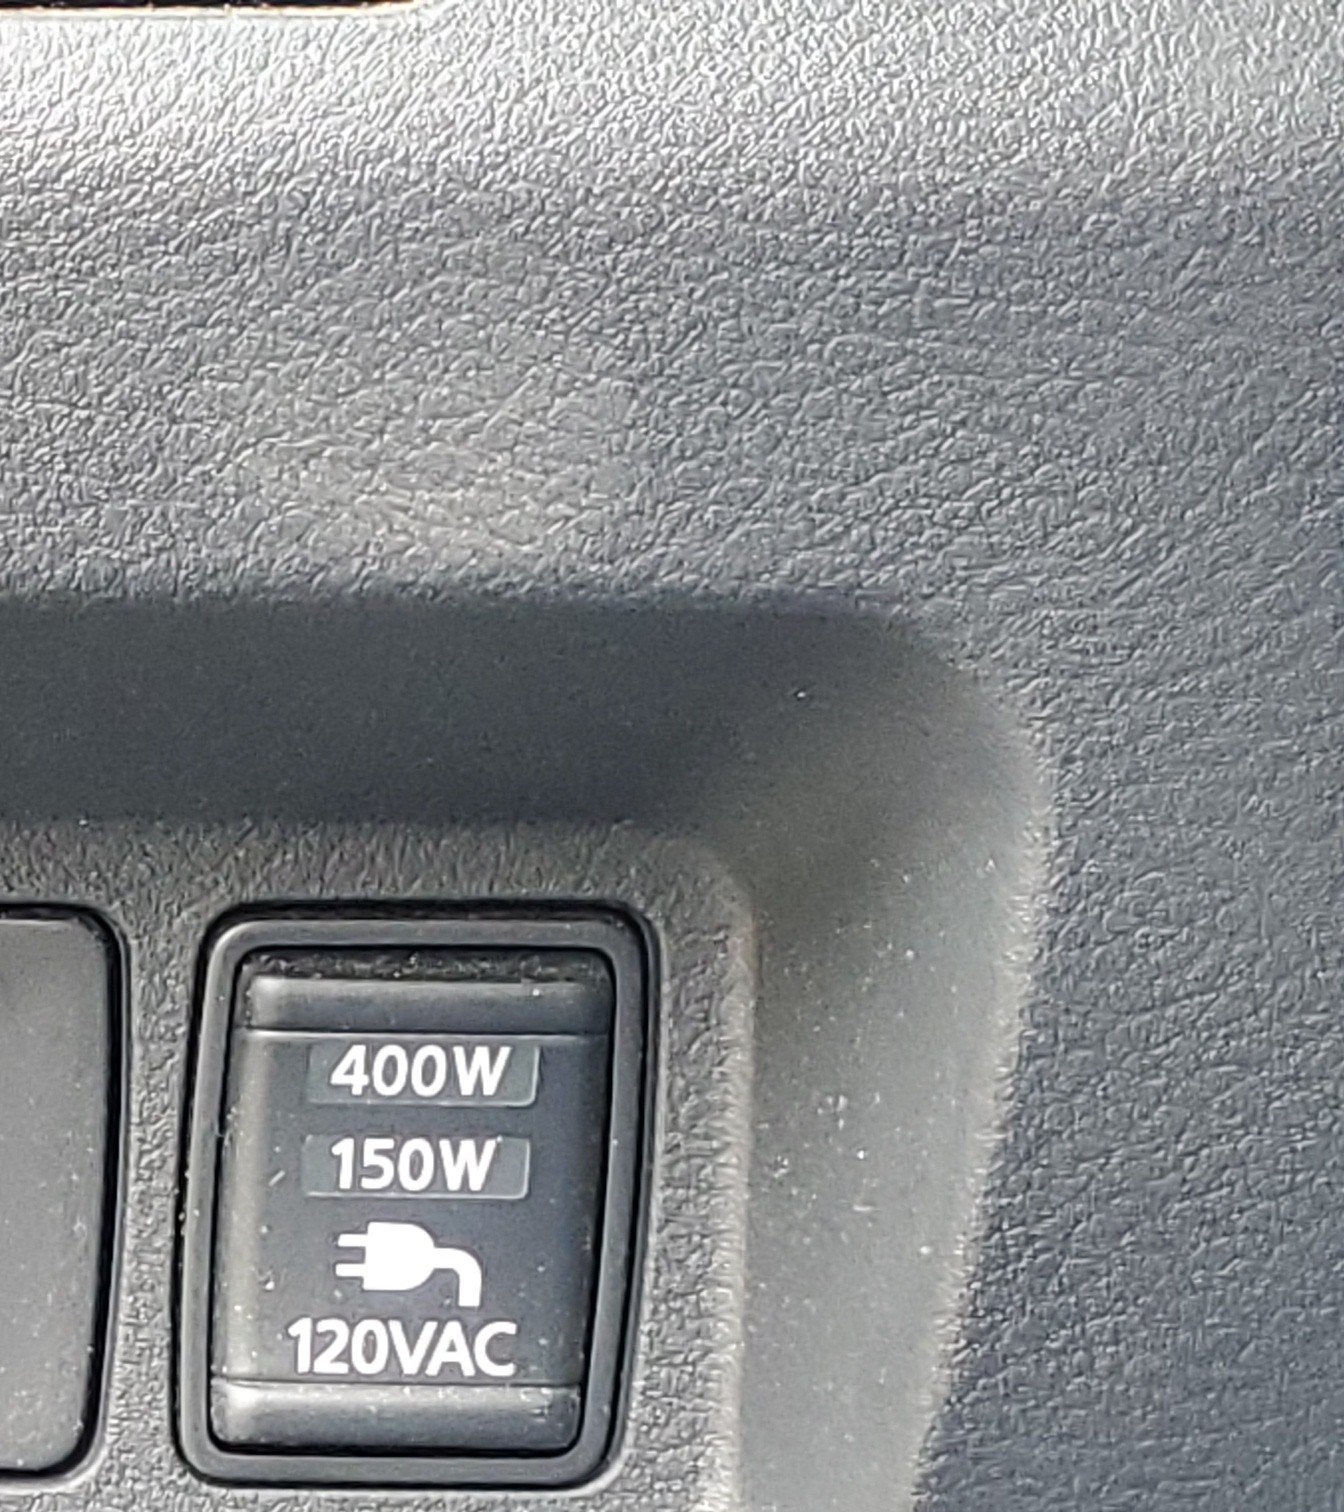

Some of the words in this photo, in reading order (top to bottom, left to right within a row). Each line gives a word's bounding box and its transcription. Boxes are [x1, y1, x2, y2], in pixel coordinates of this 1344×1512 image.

[329, 1043, 512, 1097] 400W
[329, 1137, 499, 1192] 150W
[285, 1316, 518, 1377] 120VAC
